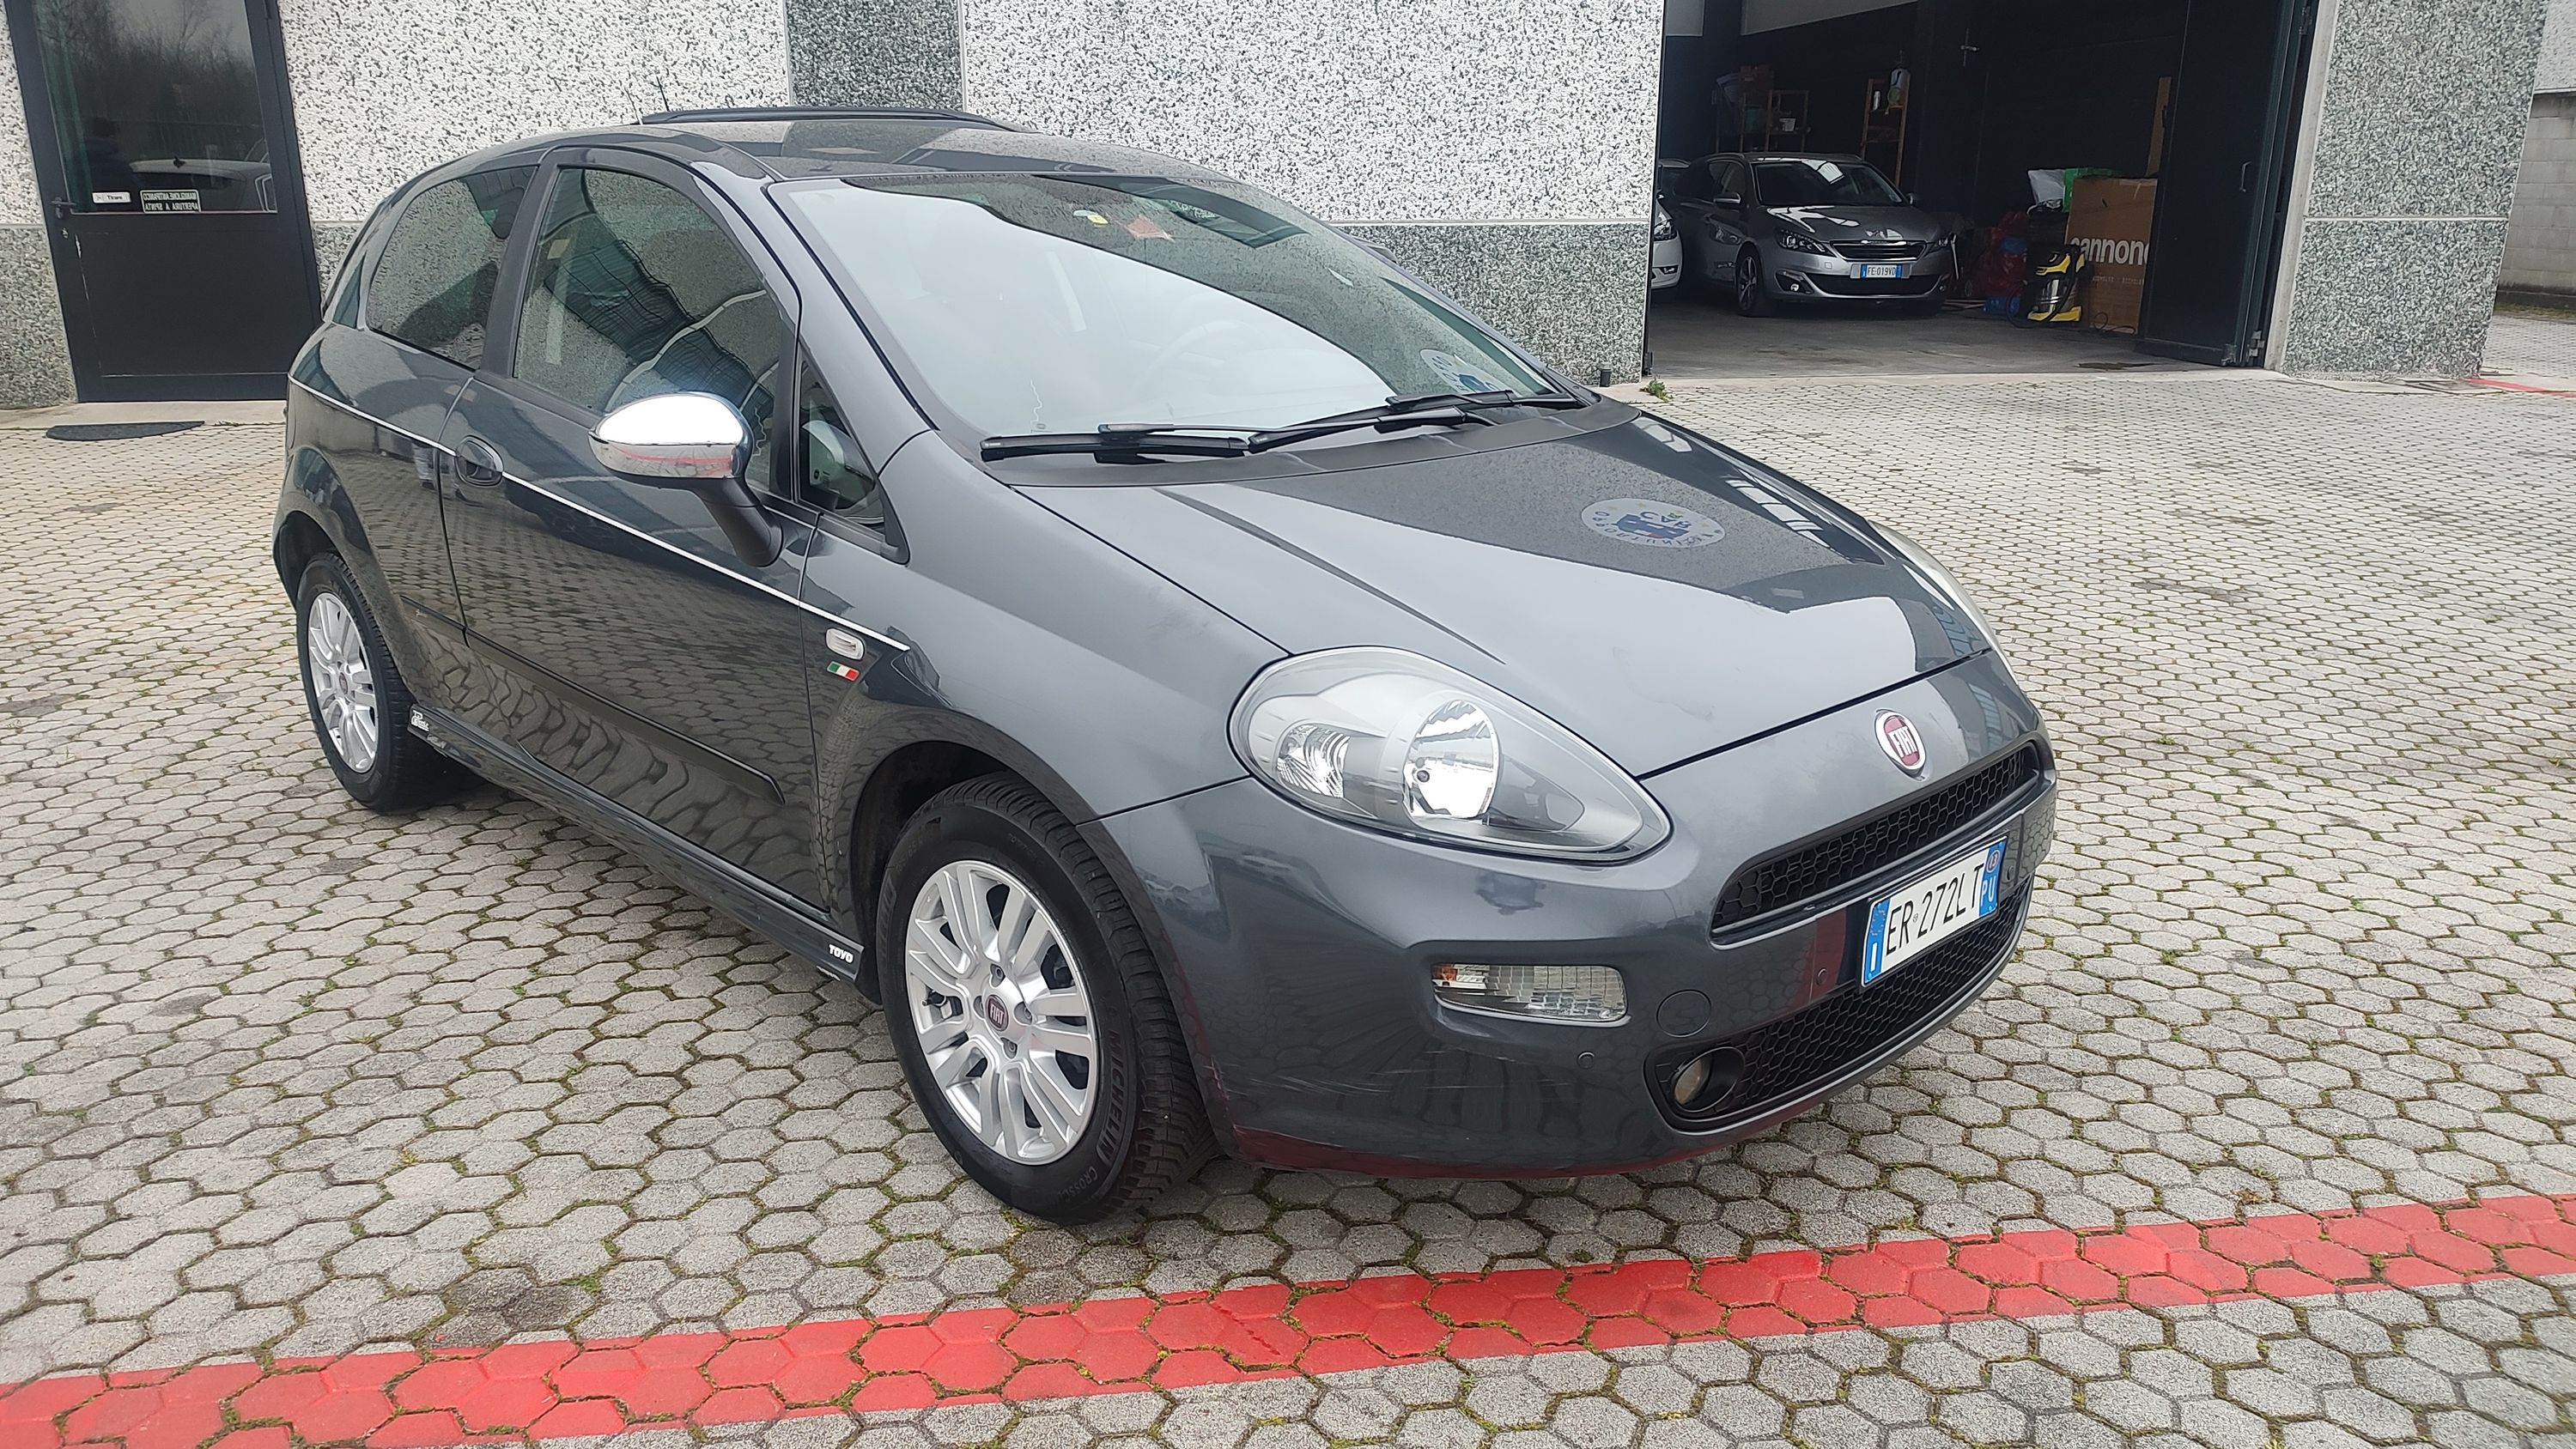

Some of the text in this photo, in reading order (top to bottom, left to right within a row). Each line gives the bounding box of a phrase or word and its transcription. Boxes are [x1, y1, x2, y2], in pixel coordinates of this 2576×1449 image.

[2070, 238, 2149, 265] annon
[1981, 876, 1996, 907] PU
[990, 1003, 1005, 1025] FIAT
[1100, 1028, 1127, 1159] MICHELIN
